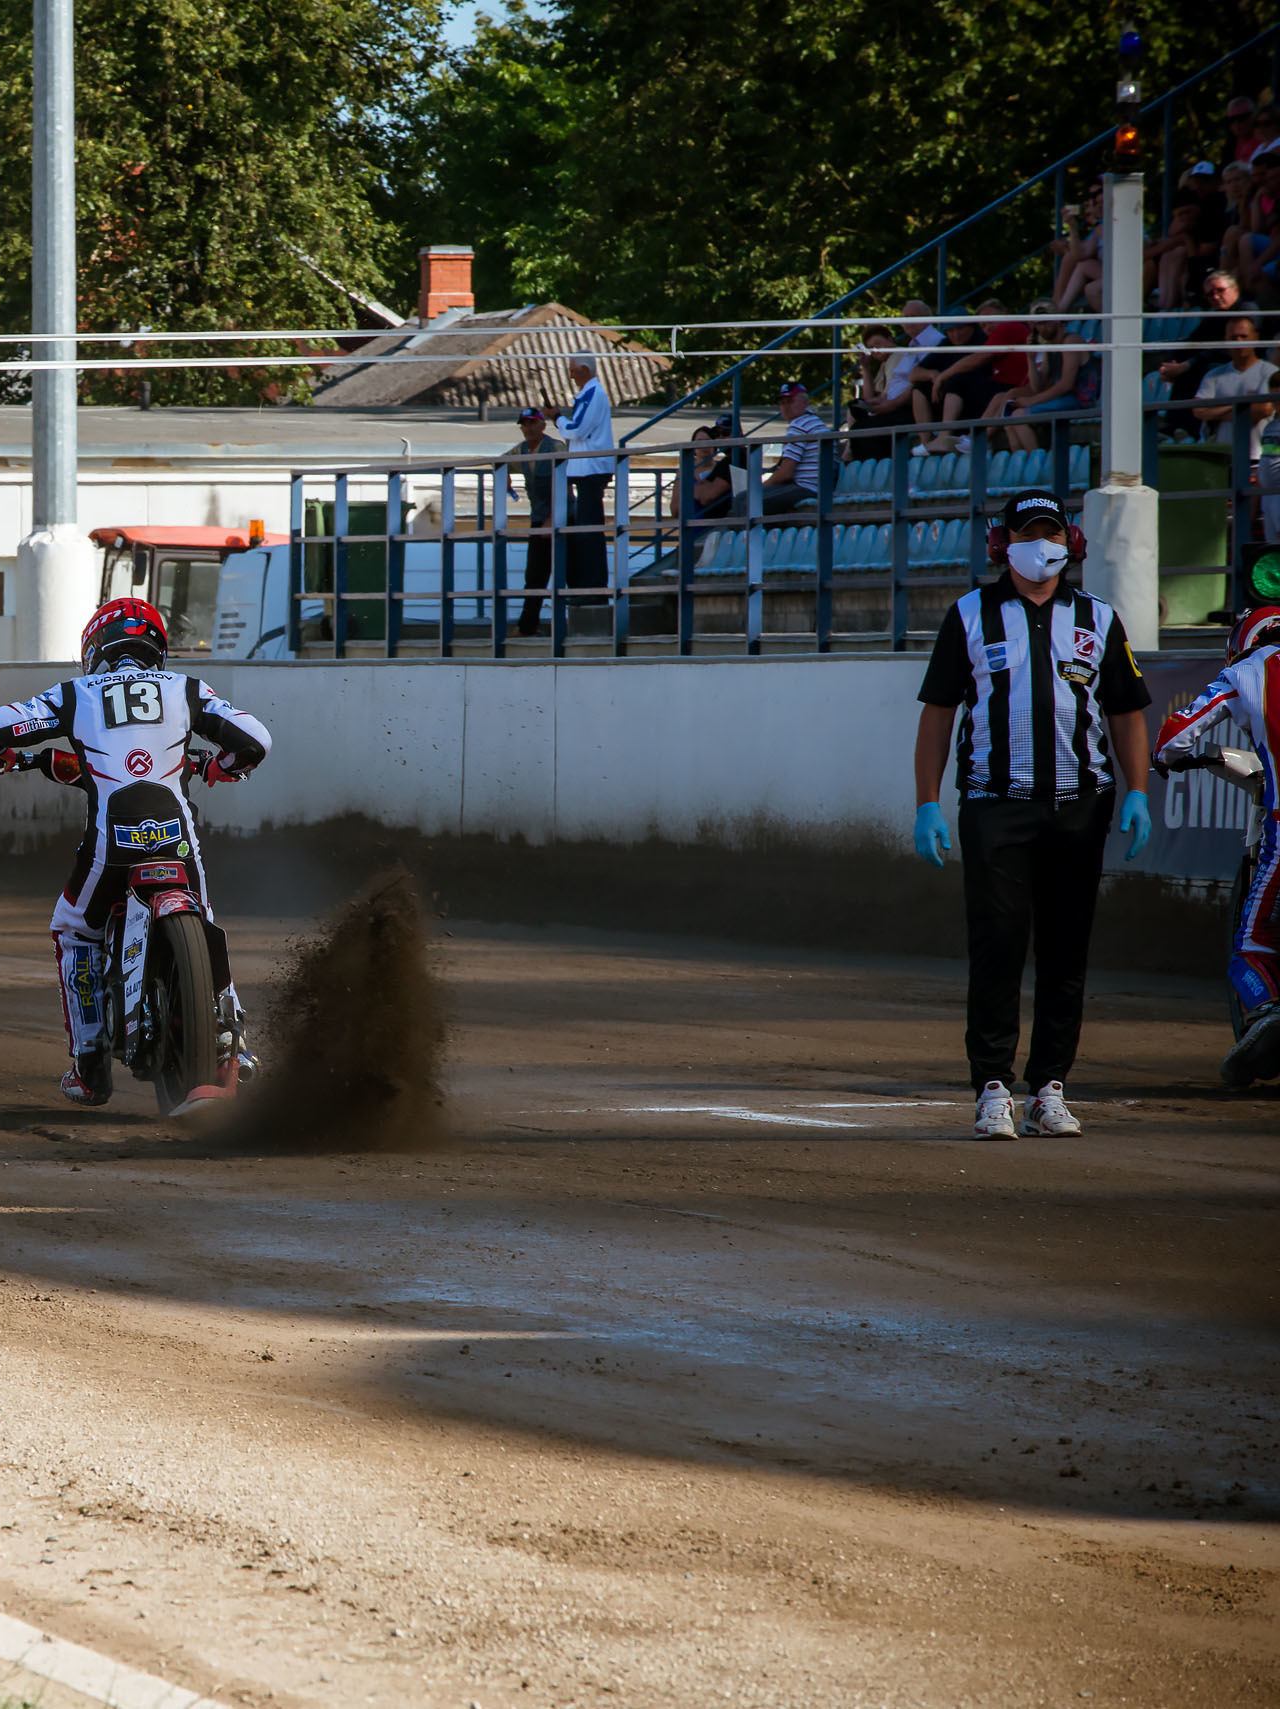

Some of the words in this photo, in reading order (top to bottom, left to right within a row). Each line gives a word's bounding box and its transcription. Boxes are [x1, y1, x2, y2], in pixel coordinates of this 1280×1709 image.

[1016, 498, 1059, 513] MARSHAL
[87, 672, 173, 688] KUDRIASHOV
[104, 681, 161, 724] 13
[130, 827, 171, 844] REALL
[76, 956, 95, 1006] REALL
